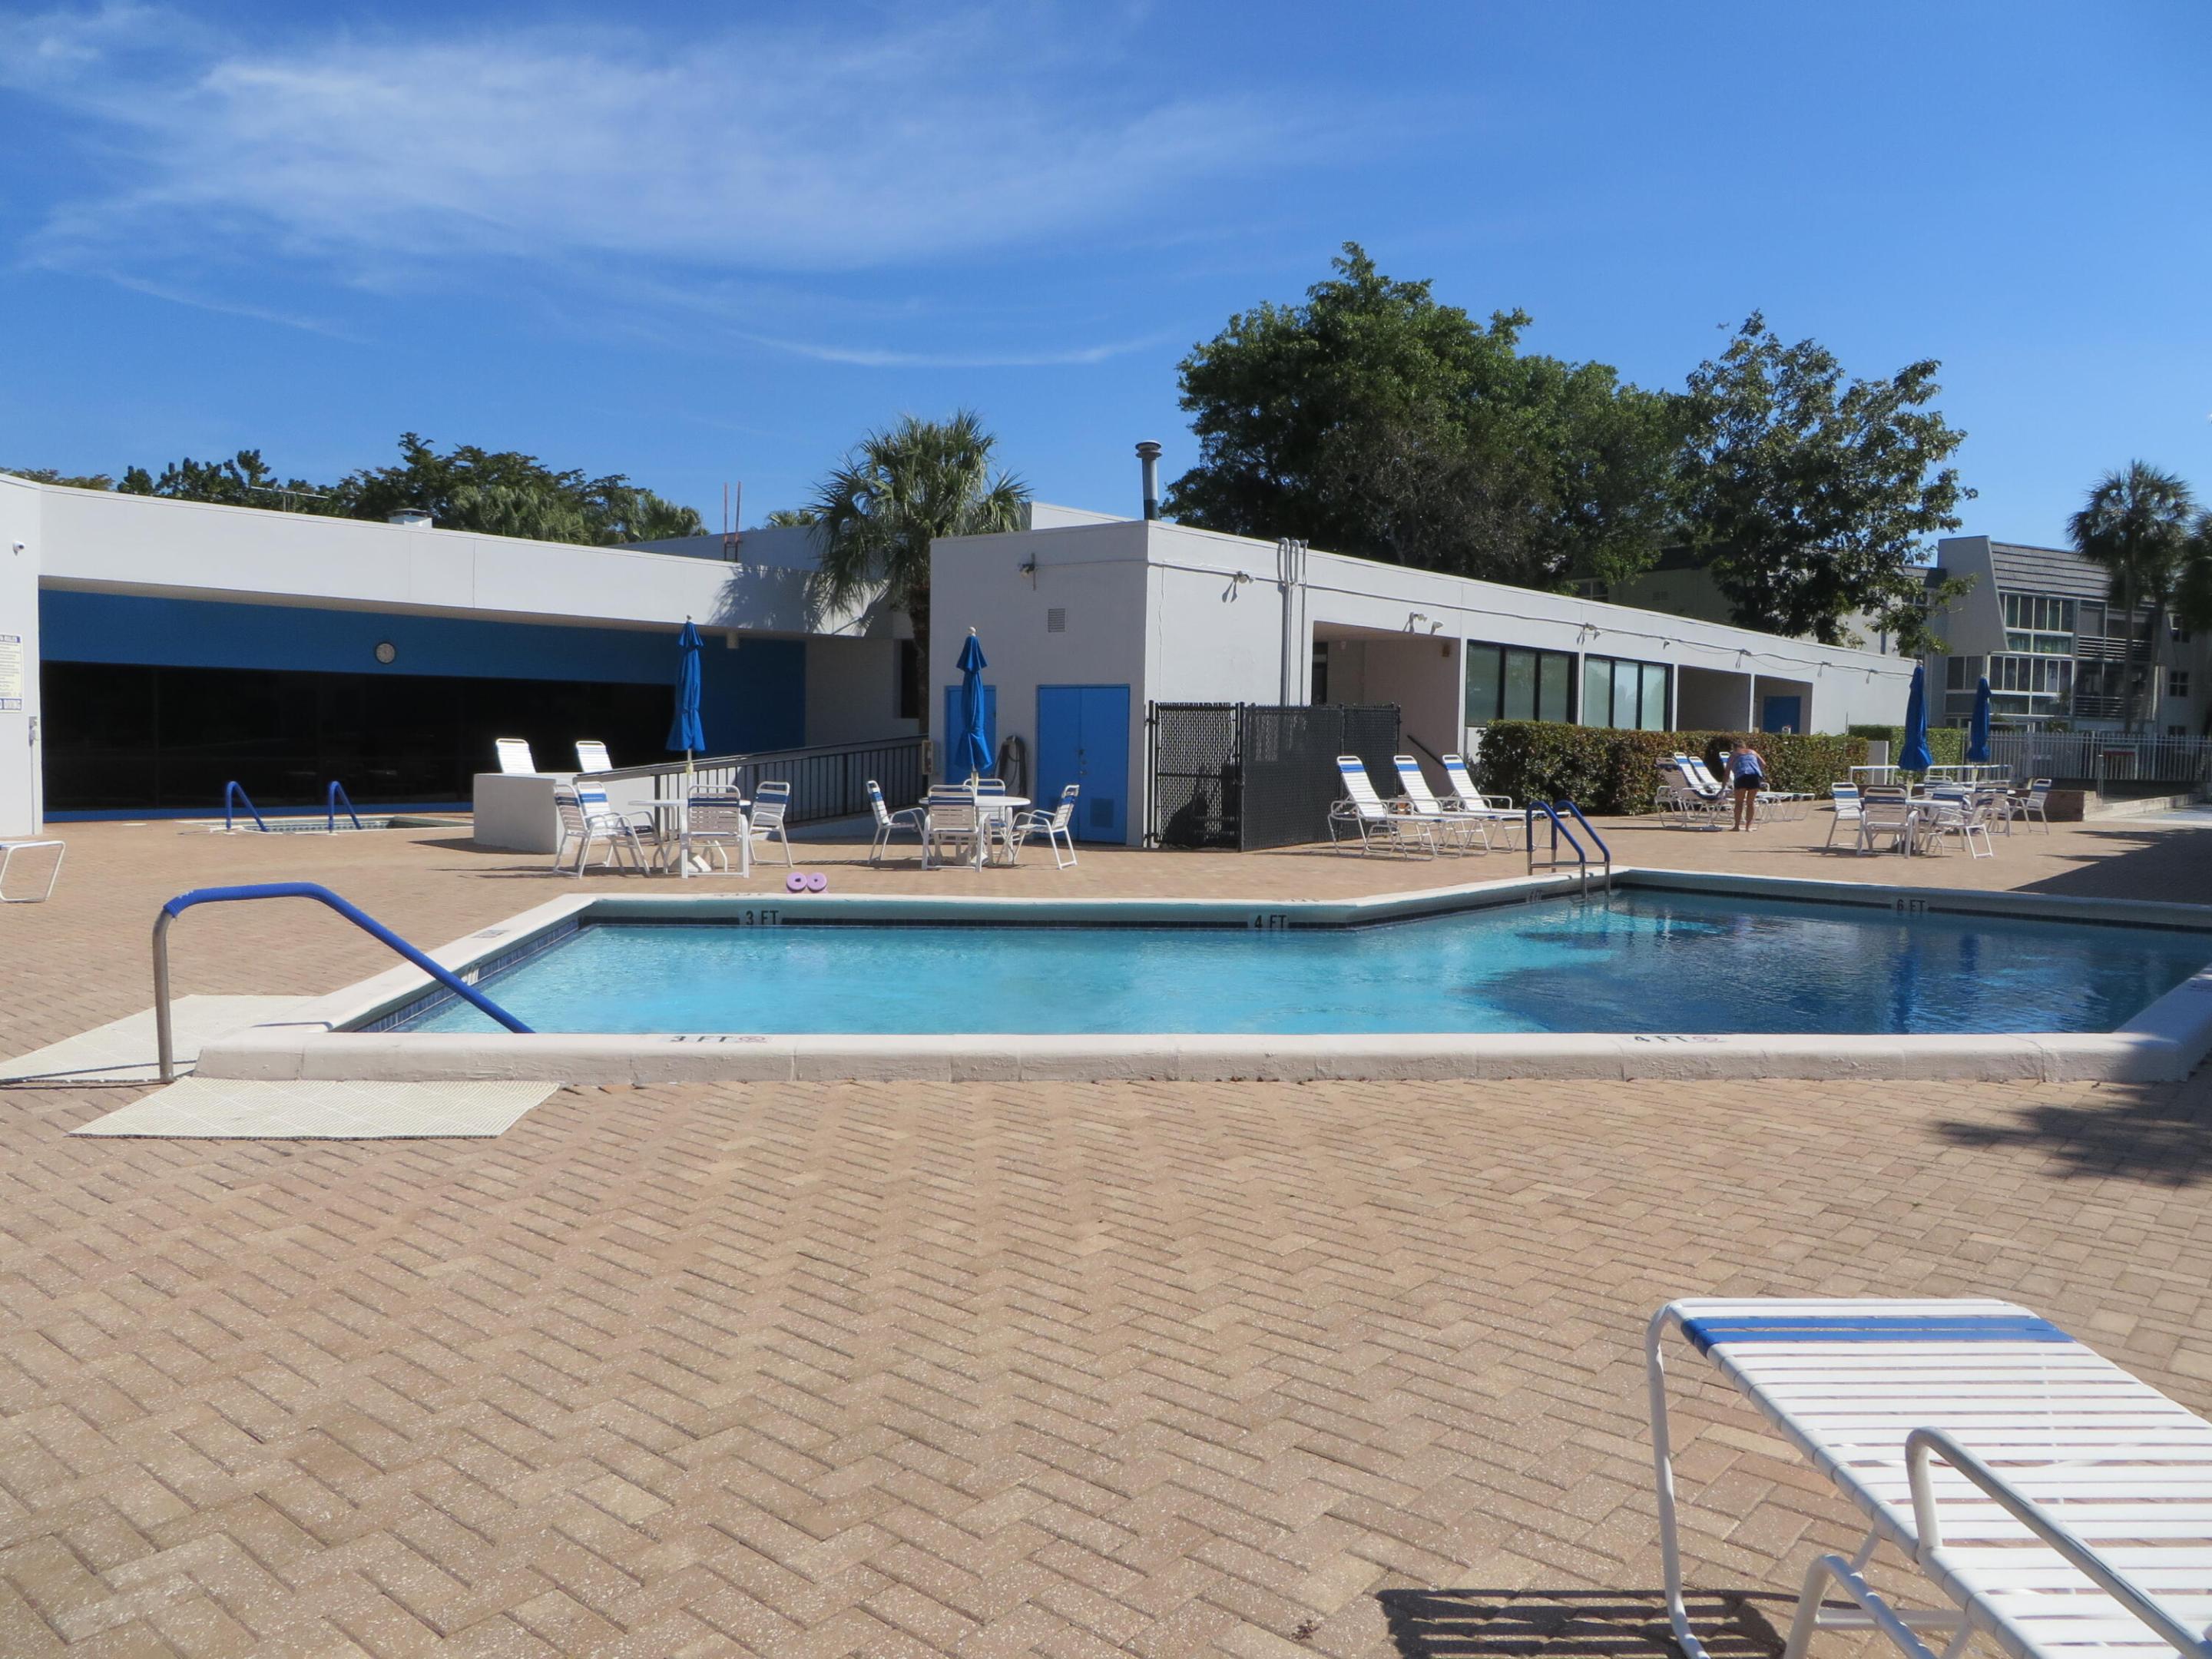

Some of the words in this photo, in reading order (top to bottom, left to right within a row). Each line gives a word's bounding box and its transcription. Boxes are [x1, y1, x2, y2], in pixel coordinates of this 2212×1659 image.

[1896, 899, 1904, 912] 6
[1909, 899, 1926, 913] FT
[746, 910, 753, 925] 3
[760, 910, 779, 926] FT
[1254, 915, 1263, 928] 4
[1270, 914, 1287, 928] FT
